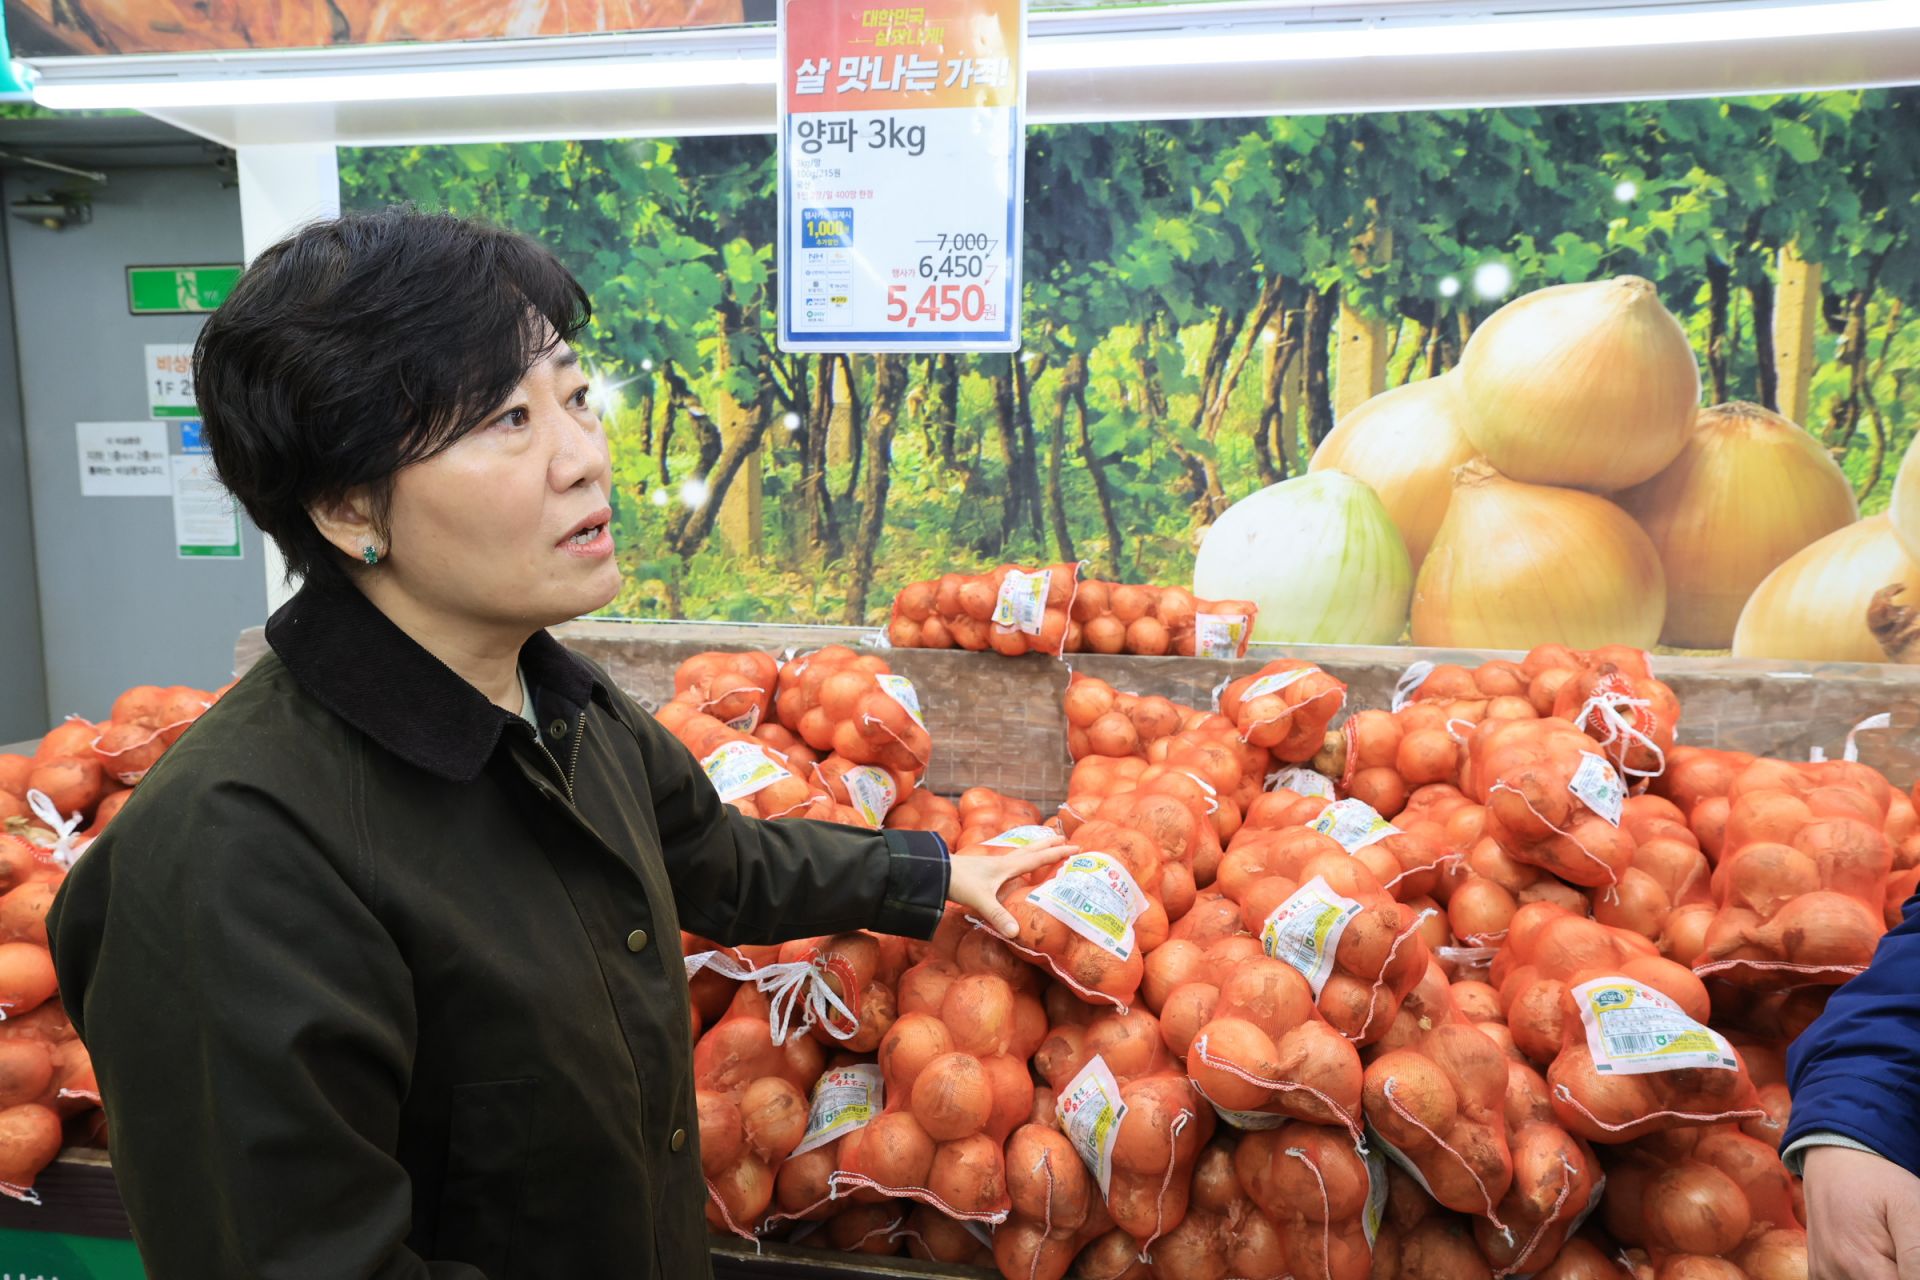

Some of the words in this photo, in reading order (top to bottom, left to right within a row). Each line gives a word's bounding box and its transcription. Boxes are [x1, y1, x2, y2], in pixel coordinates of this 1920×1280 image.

[862, 8, 926, 28] 대한민국
[796, 58, 832, 95] 살
[836, 54, 940, 94] 맛나는
[944, 56, 1010, 89] 가격!
[797, 118, 859, 154] 양파
[868, 117, 926, 157] 3kg
[936, 233, 989, 254] 7,000
[919, 255, 983, 282] 6,450
[156, 355, 194, 374] 비상
[155, 380, 174, 396] 1F
